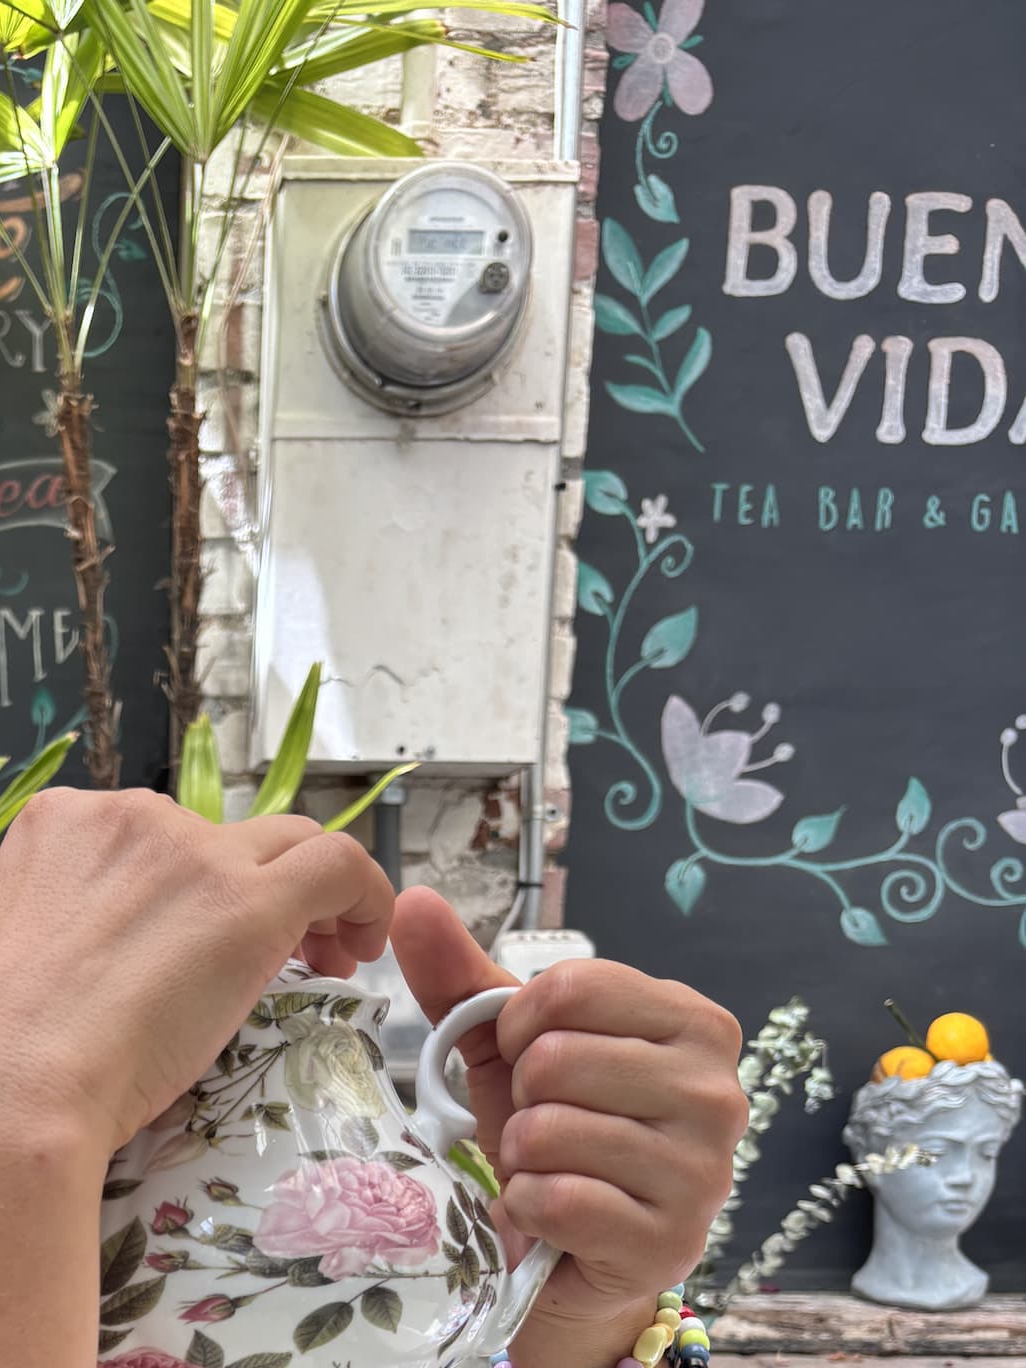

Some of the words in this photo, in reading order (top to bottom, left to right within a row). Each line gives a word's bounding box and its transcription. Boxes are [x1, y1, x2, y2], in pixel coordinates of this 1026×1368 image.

[785, 331, 1026, 446] VID
[710, 483, 780, 527] TEA
[818, 486, 895, 532] BAR
[923, 495, 947, 528] &
[971, 490, 1020, 534] GA
